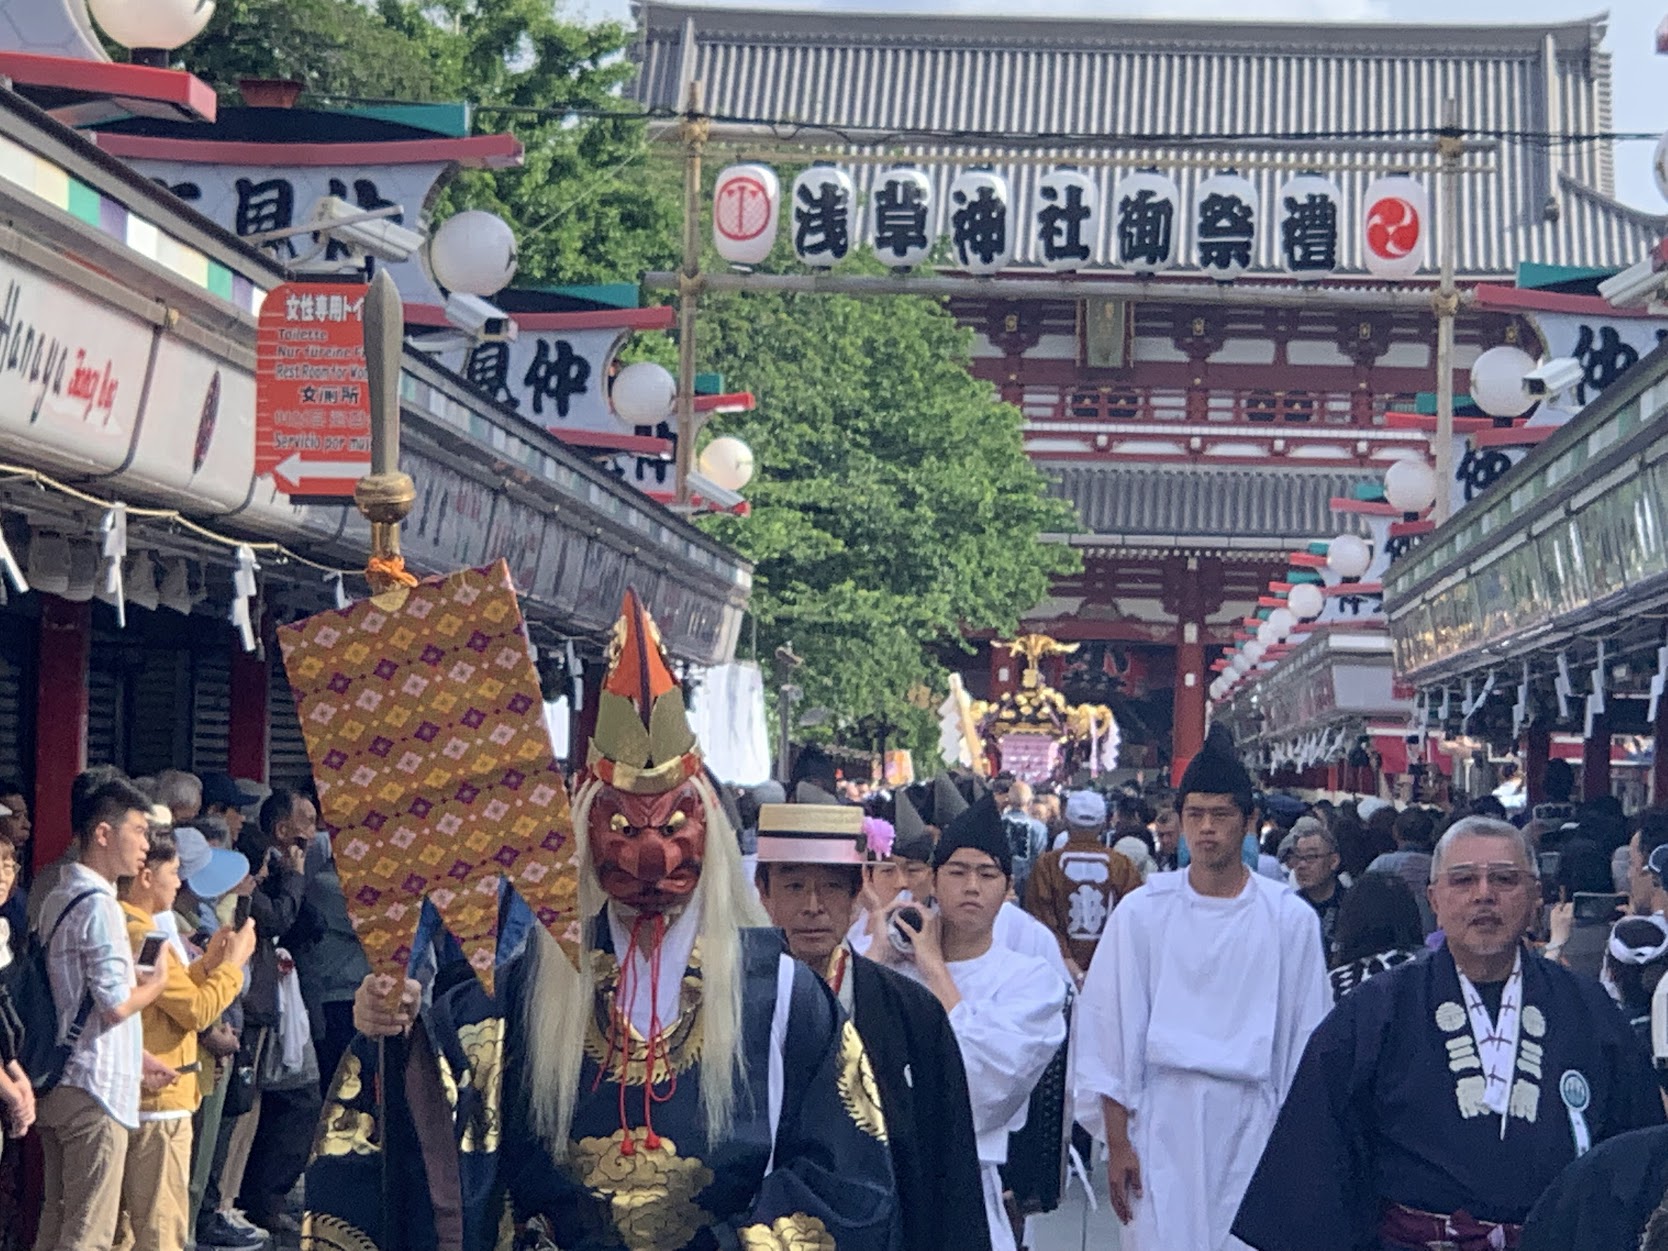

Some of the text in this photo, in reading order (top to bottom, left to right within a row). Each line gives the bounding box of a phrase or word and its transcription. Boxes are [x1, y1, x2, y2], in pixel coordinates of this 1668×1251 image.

[278, 328, 327, 341] Toilette
[277, 345, 300, 357] Nur
[276, 364, 300, 379] Rest
